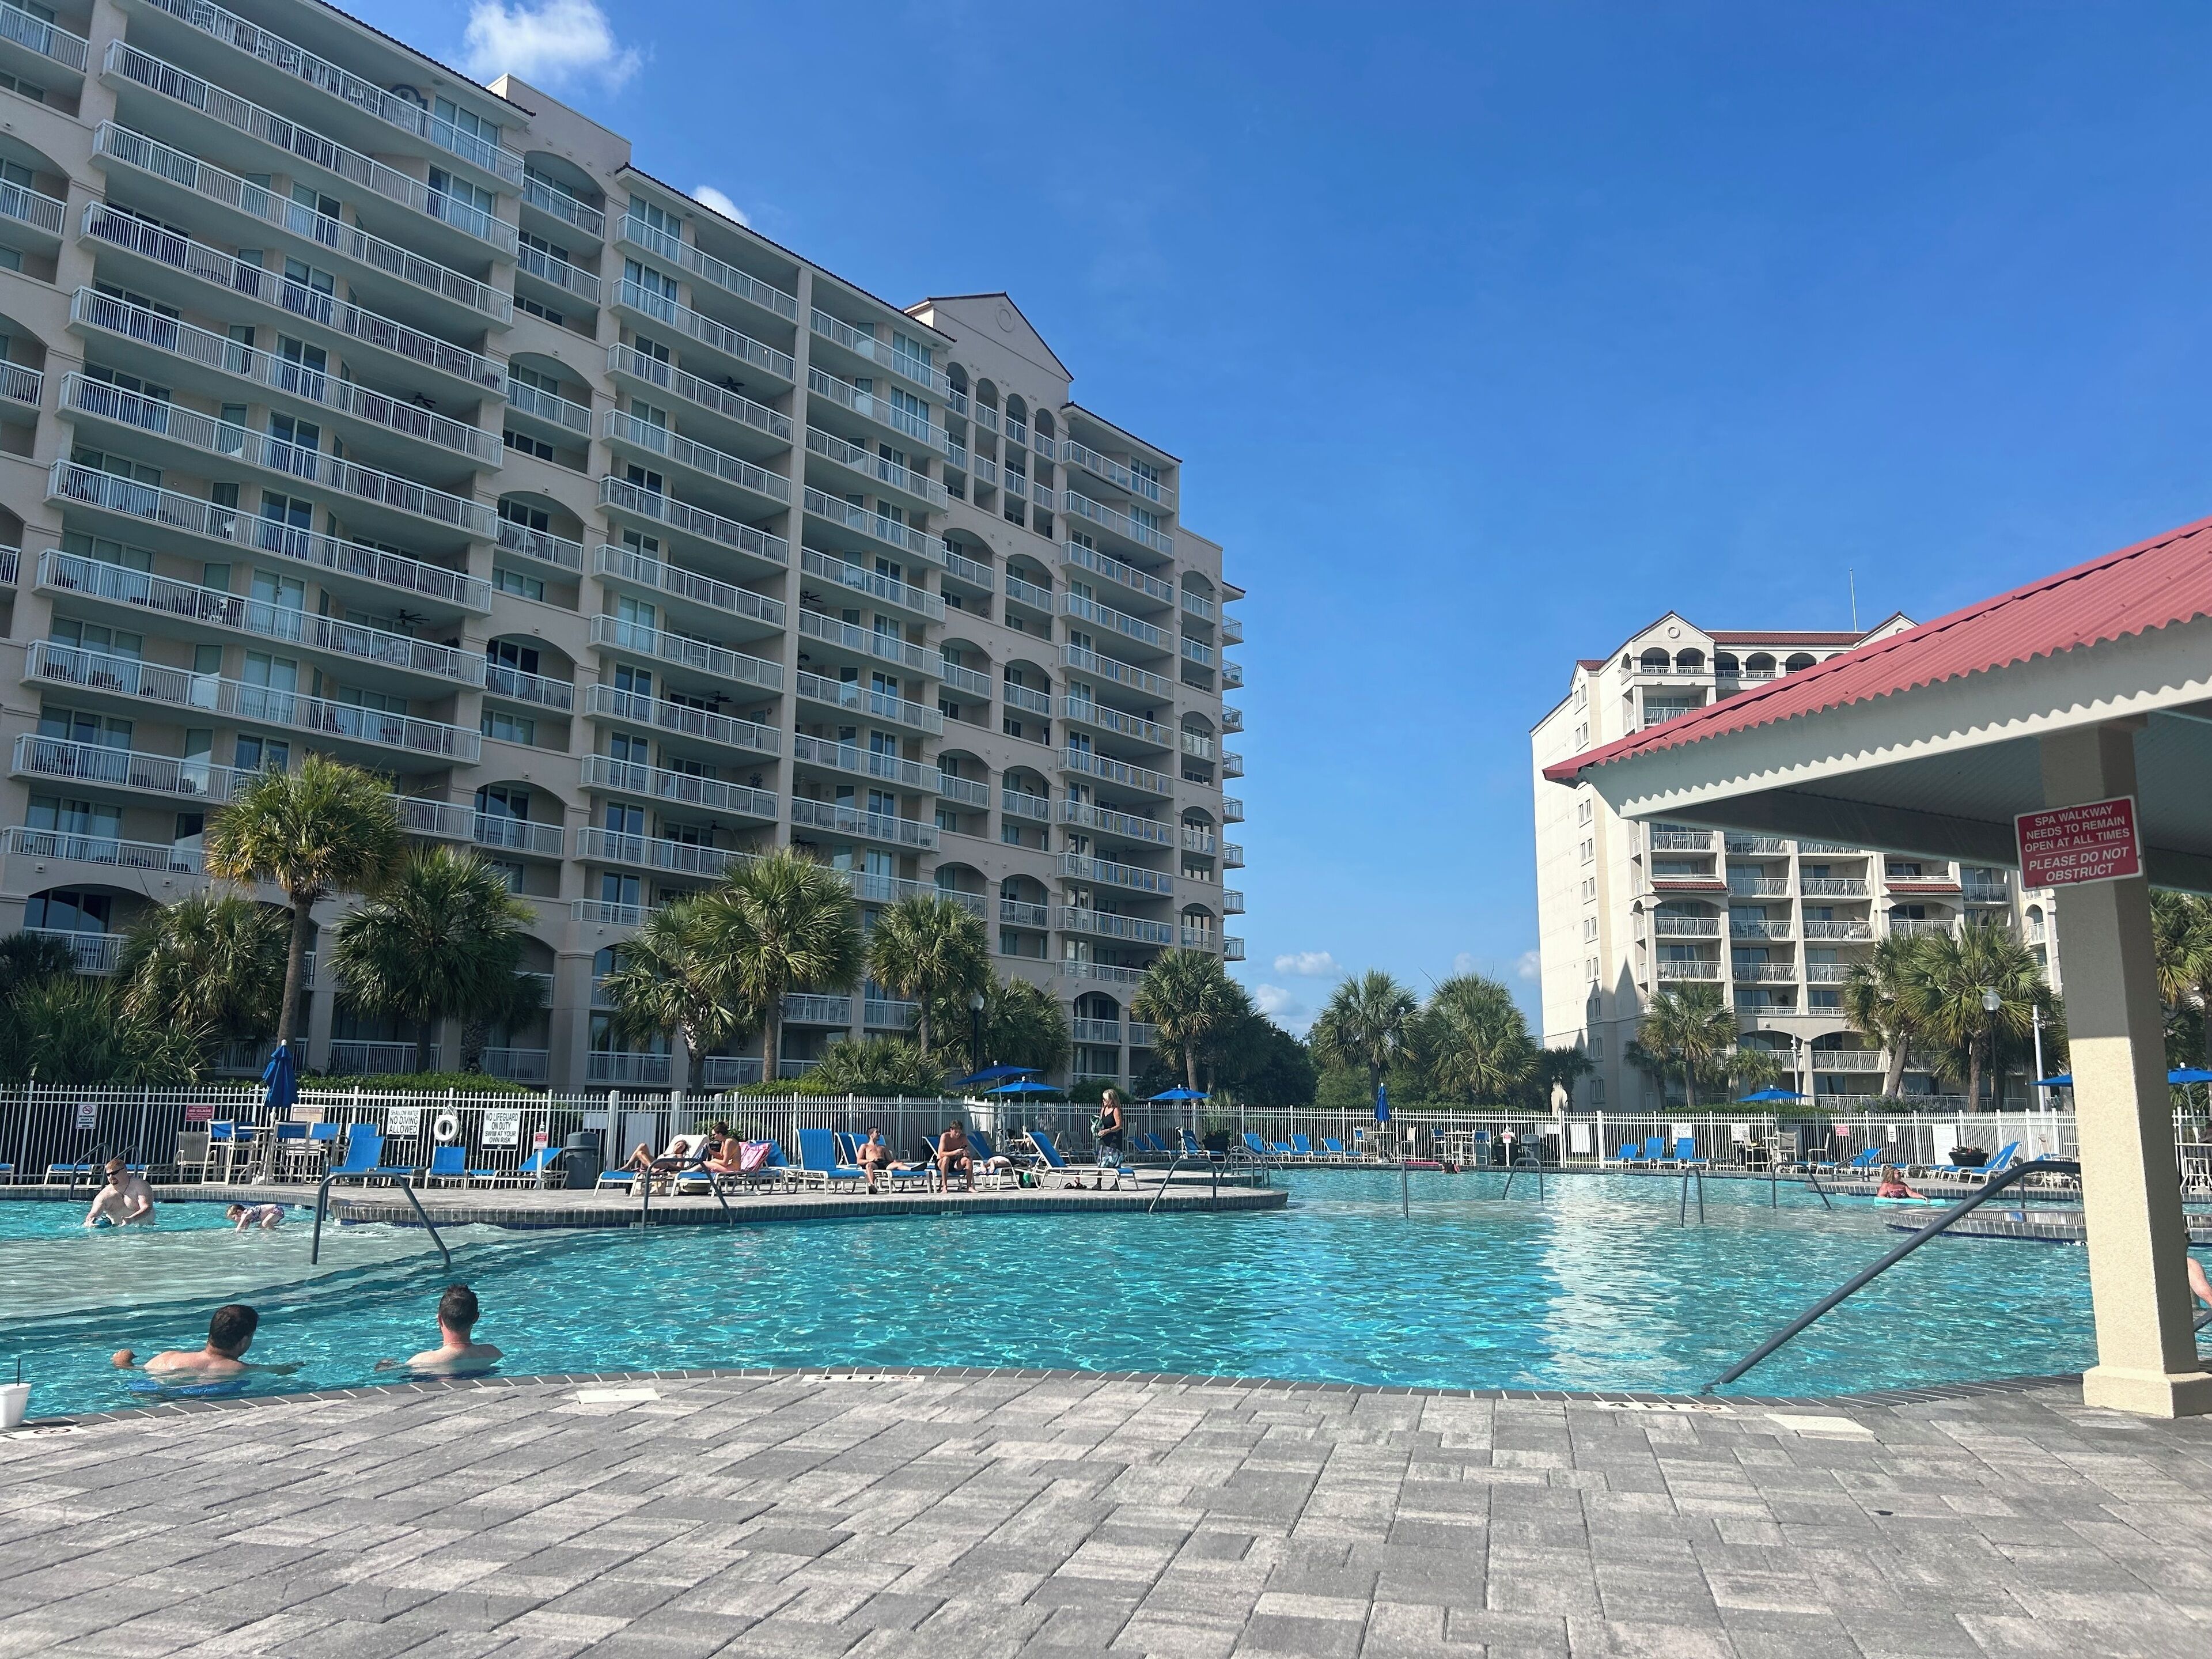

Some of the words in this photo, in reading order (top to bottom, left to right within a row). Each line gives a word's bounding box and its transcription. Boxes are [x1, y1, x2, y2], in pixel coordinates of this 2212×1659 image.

[2035, 816, 2056, 827] SPA
[2058, 805, 2113, 822] WALKWAY
[2026, 826, 2062, 840] NEEDS
[2064, 824, 2080, 834] TO
[2082, 816, 2125, 831] REMAIN
[2024, 839, 2054, 853] OPEN
[2057, 837, 2070, 848] AT
[2073, 834, 2094, 845] ALL
[2096, 828, 2130, 842] TIMES
[2029, 855, 2077, 870] PLEASE
[2080, 851, 2099, 863] DO
[2103, 846, 2129, 860] NOT
[2046, 863, 2114, 882] OBSTRUCT
[389, 1116, 398, 1124] NO
[399, 1116, 418, 1125] DIVING
[486, 1112, 493, 1121] NO
[494, 1112, 518, 1122] LIFEGUARD
[491, 1122, 498, 1130] ON
[499, 1122, 511, 1130] DUTY
[389, 1125, 418, 1134] ALLOWED
